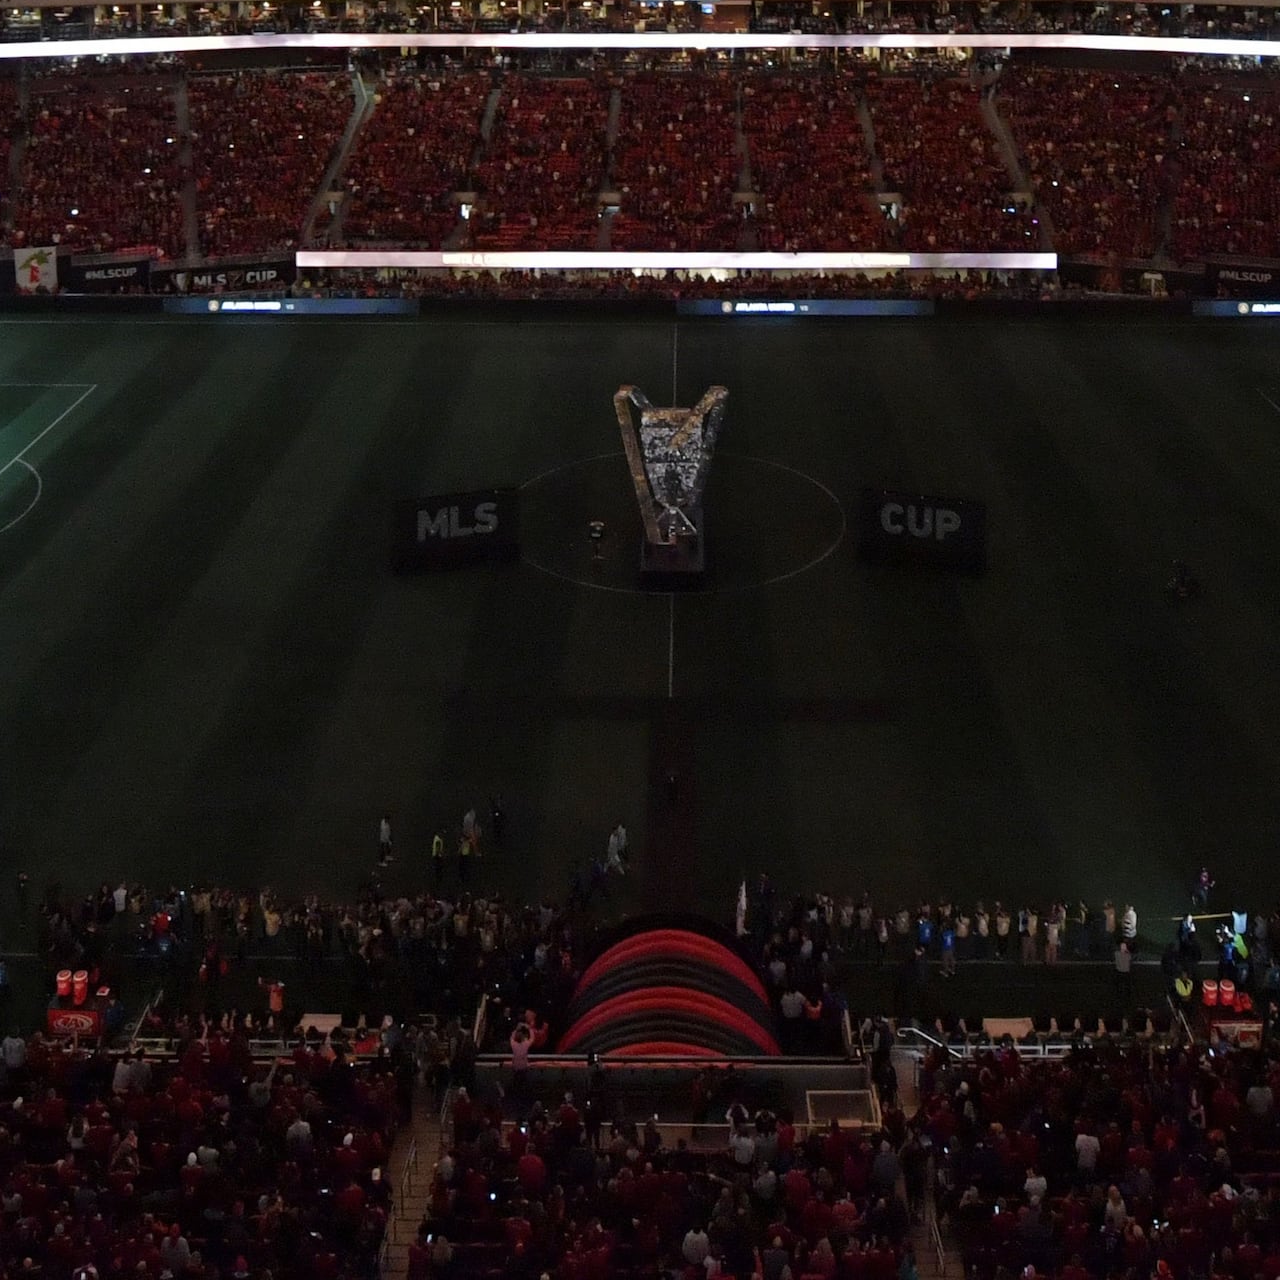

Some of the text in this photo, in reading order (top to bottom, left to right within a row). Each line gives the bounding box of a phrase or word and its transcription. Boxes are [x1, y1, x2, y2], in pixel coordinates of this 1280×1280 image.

[193, 270, 278, 288] MLS CUP
[416, 502, 499, 542] MLS
[880, 502, 961, 540] CUP
